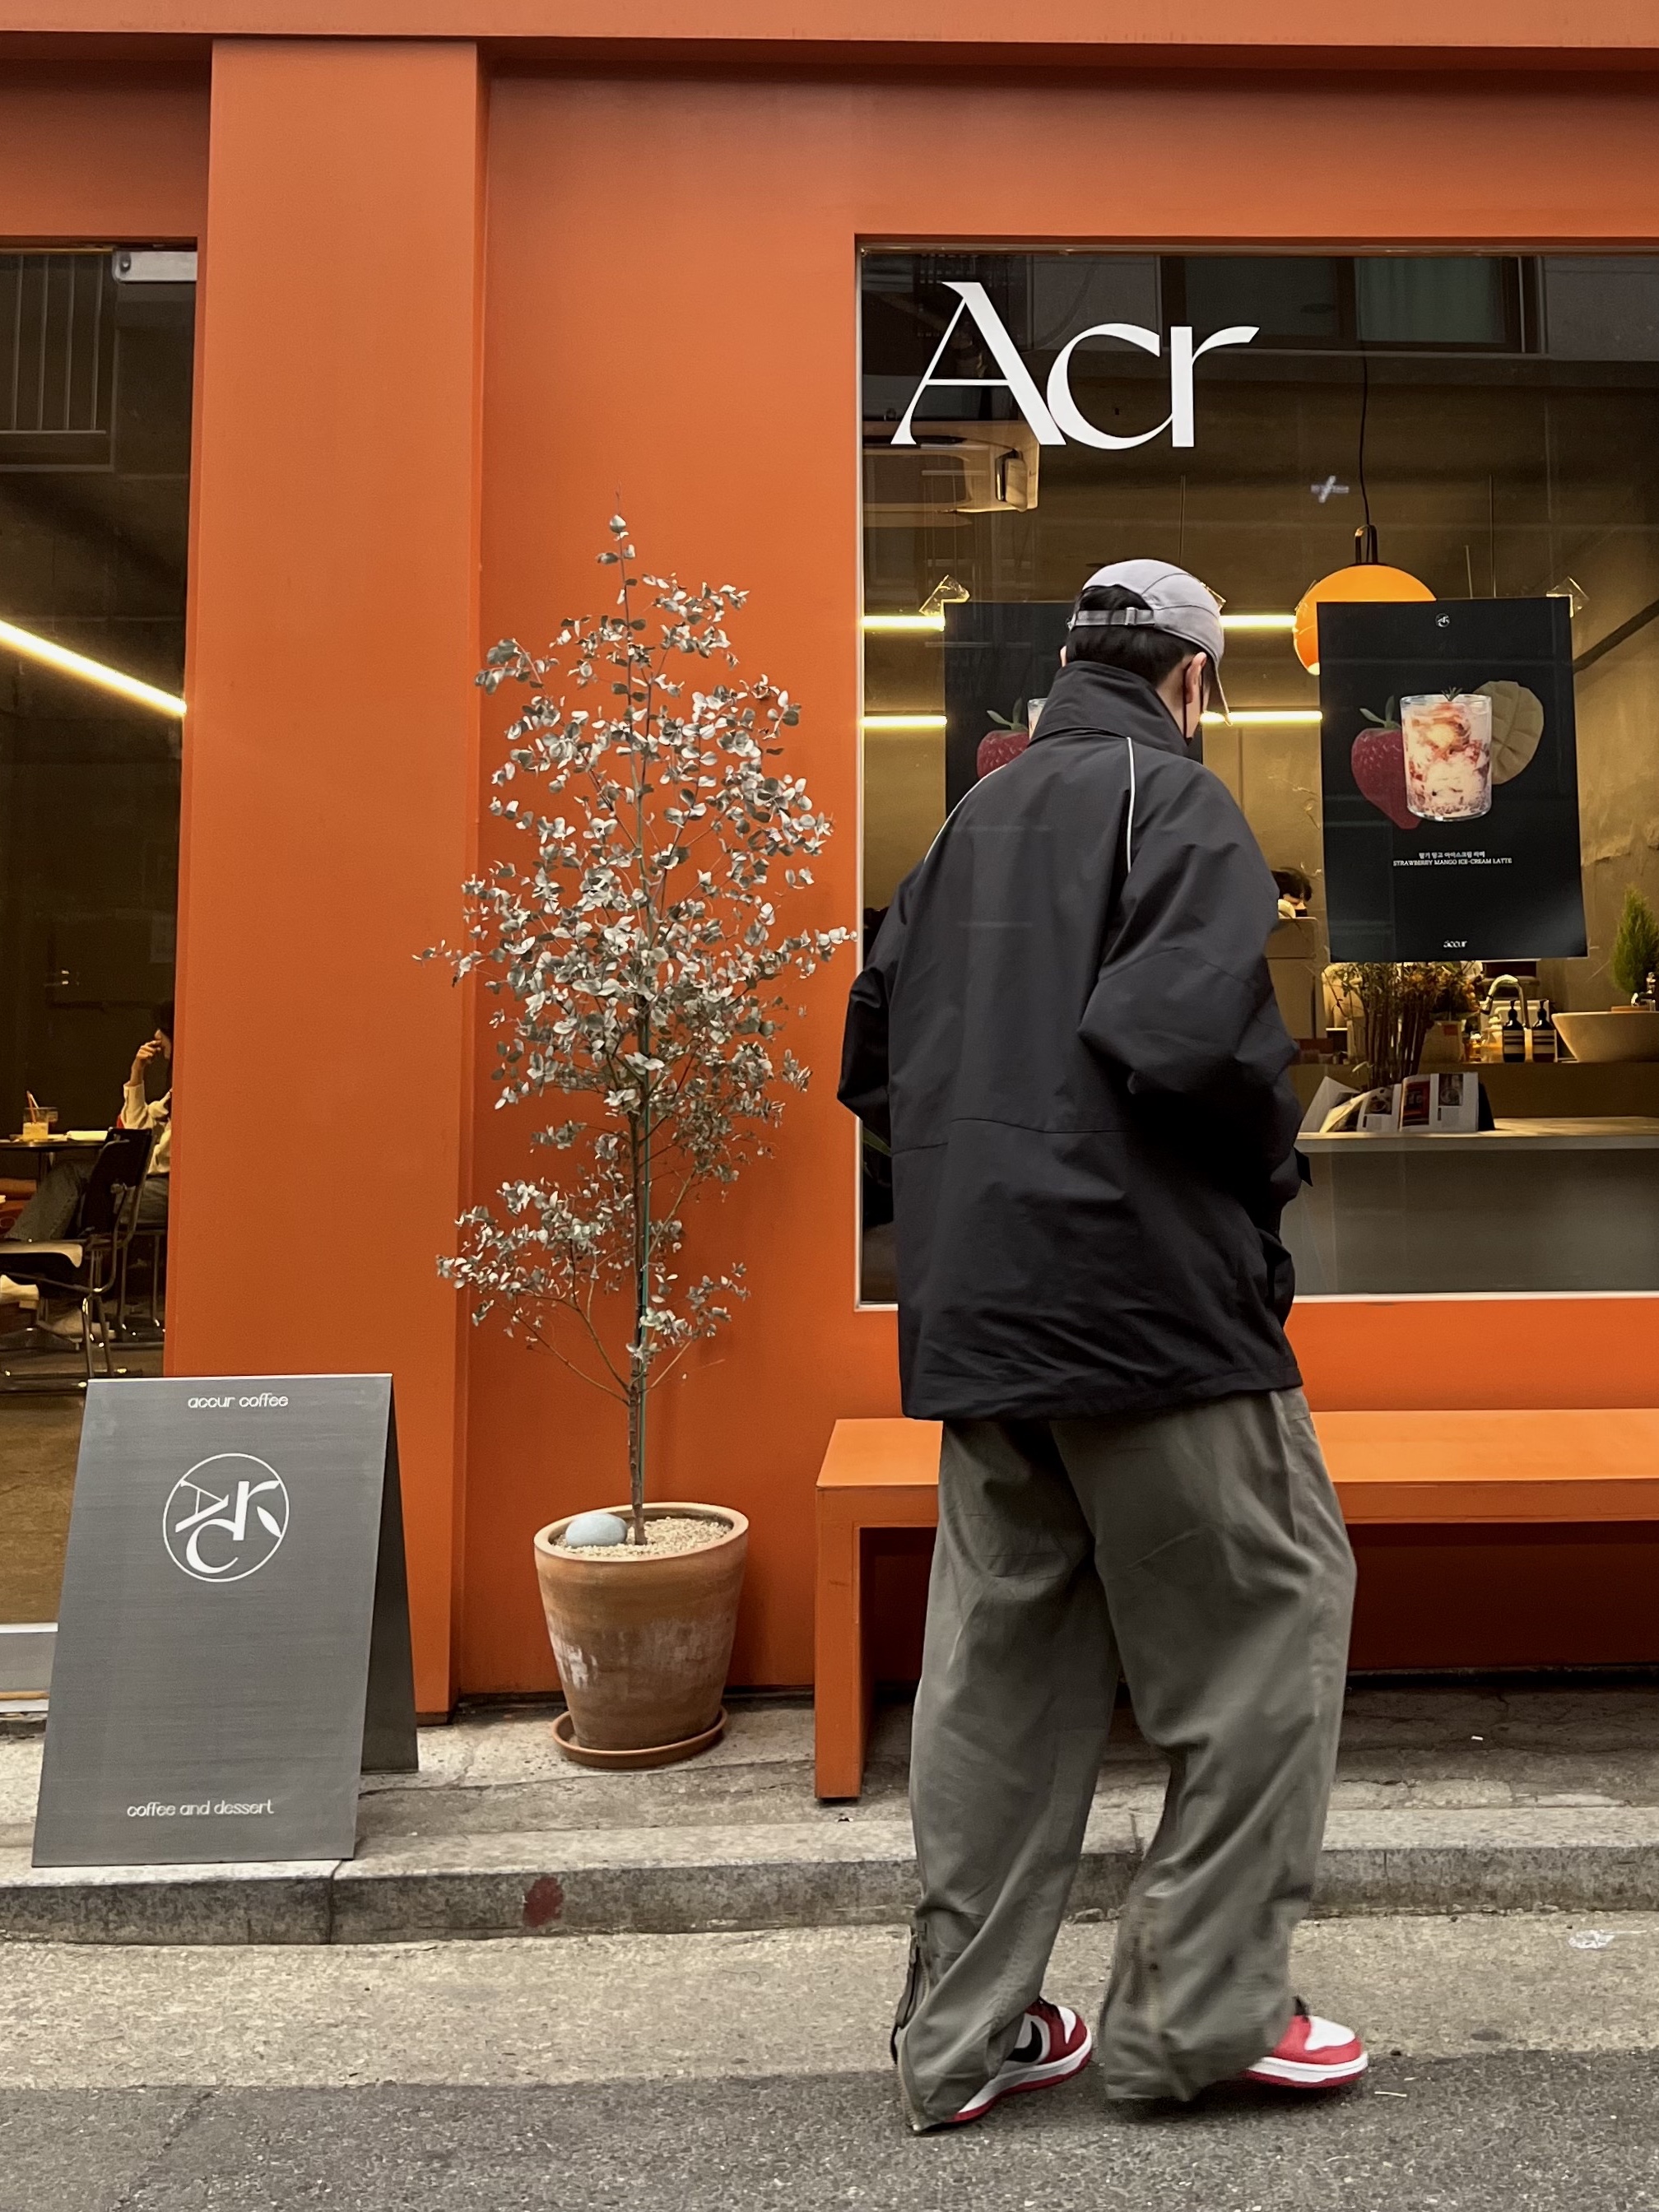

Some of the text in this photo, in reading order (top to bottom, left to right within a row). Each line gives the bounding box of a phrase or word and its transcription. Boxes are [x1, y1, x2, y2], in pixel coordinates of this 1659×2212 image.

[890, 281, 1260, 450] Acr
[188, 1392, 289, 1408] accur coffee
[127, 1799, 274, 1817] coffee and dessert
